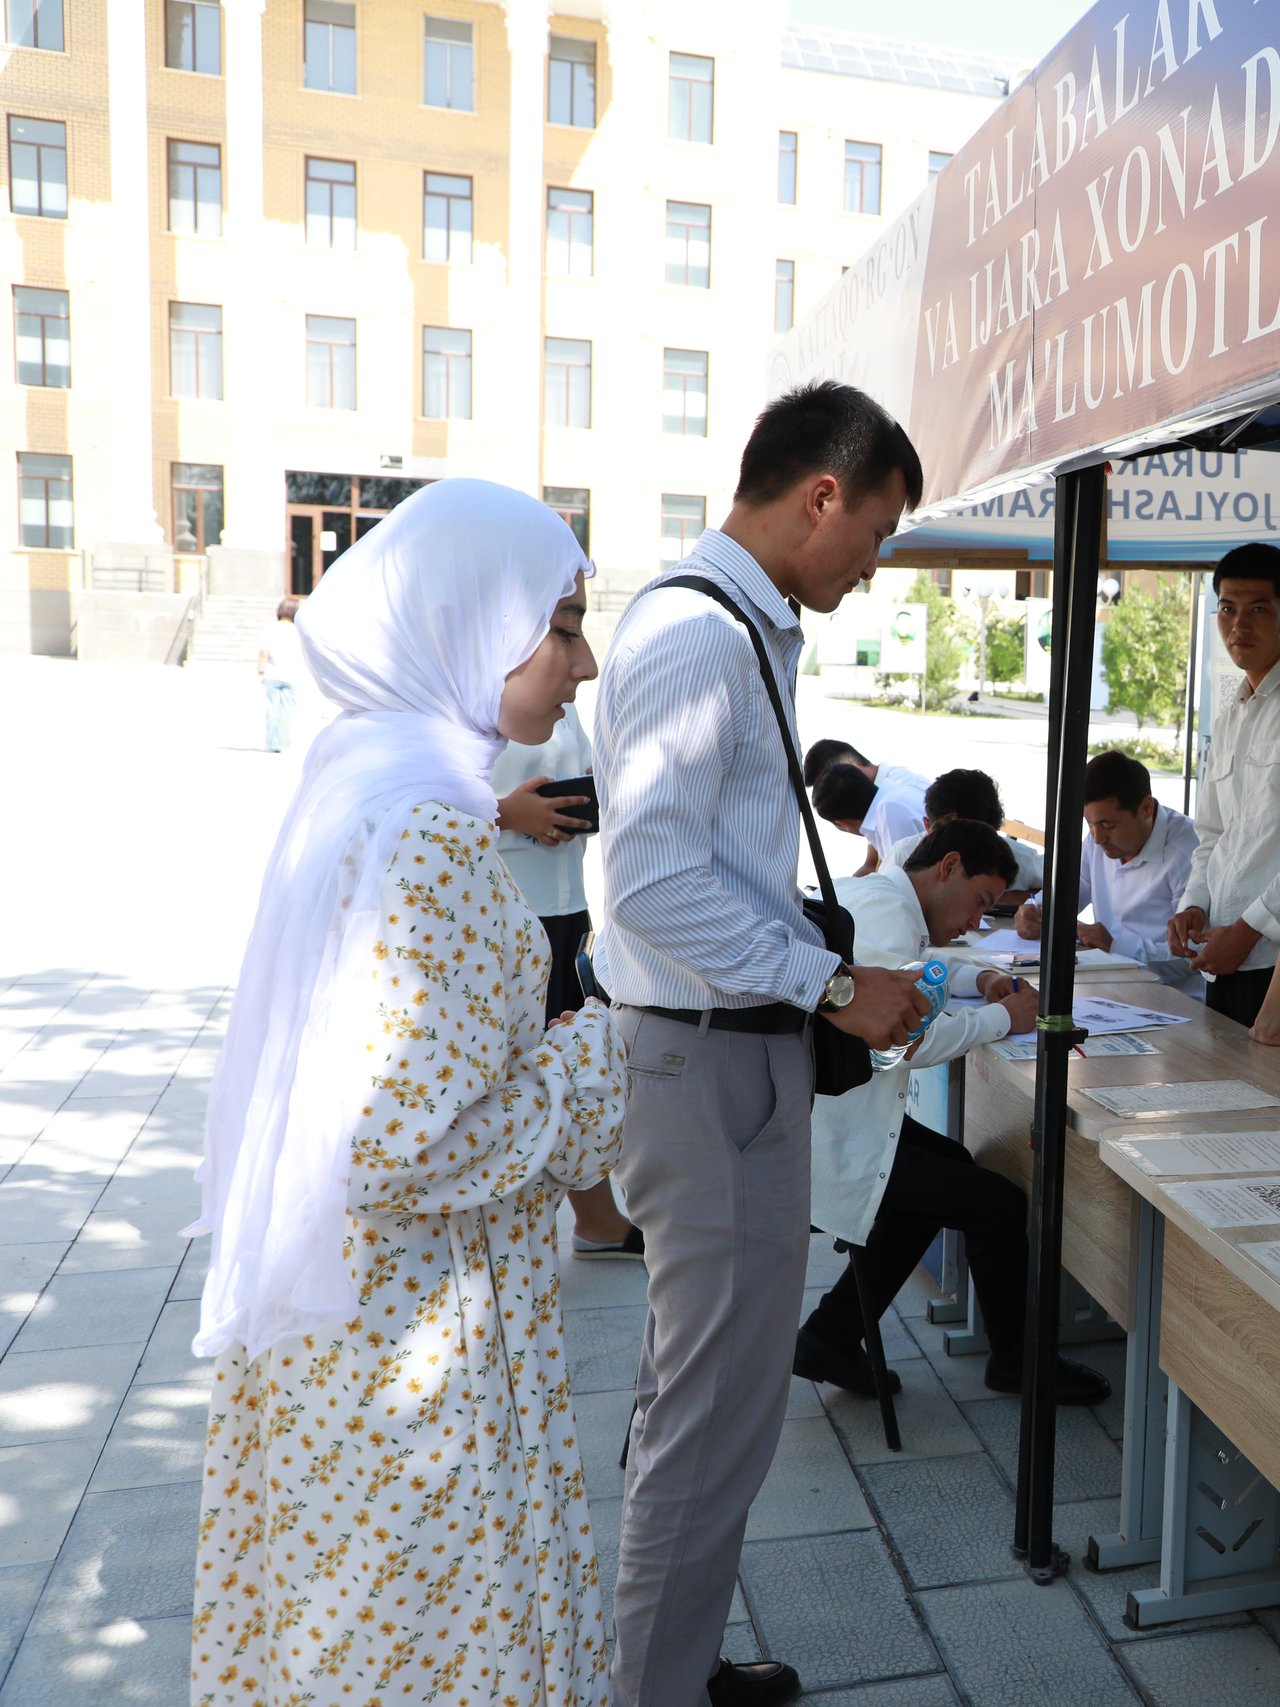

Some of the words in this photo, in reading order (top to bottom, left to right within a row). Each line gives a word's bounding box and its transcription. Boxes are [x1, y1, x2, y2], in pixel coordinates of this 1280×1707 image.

[964, 0, 1223, 248] TALABALAR
[924, 291, 960, 378] VA
[969, 208, 1069, 352] IJARA
